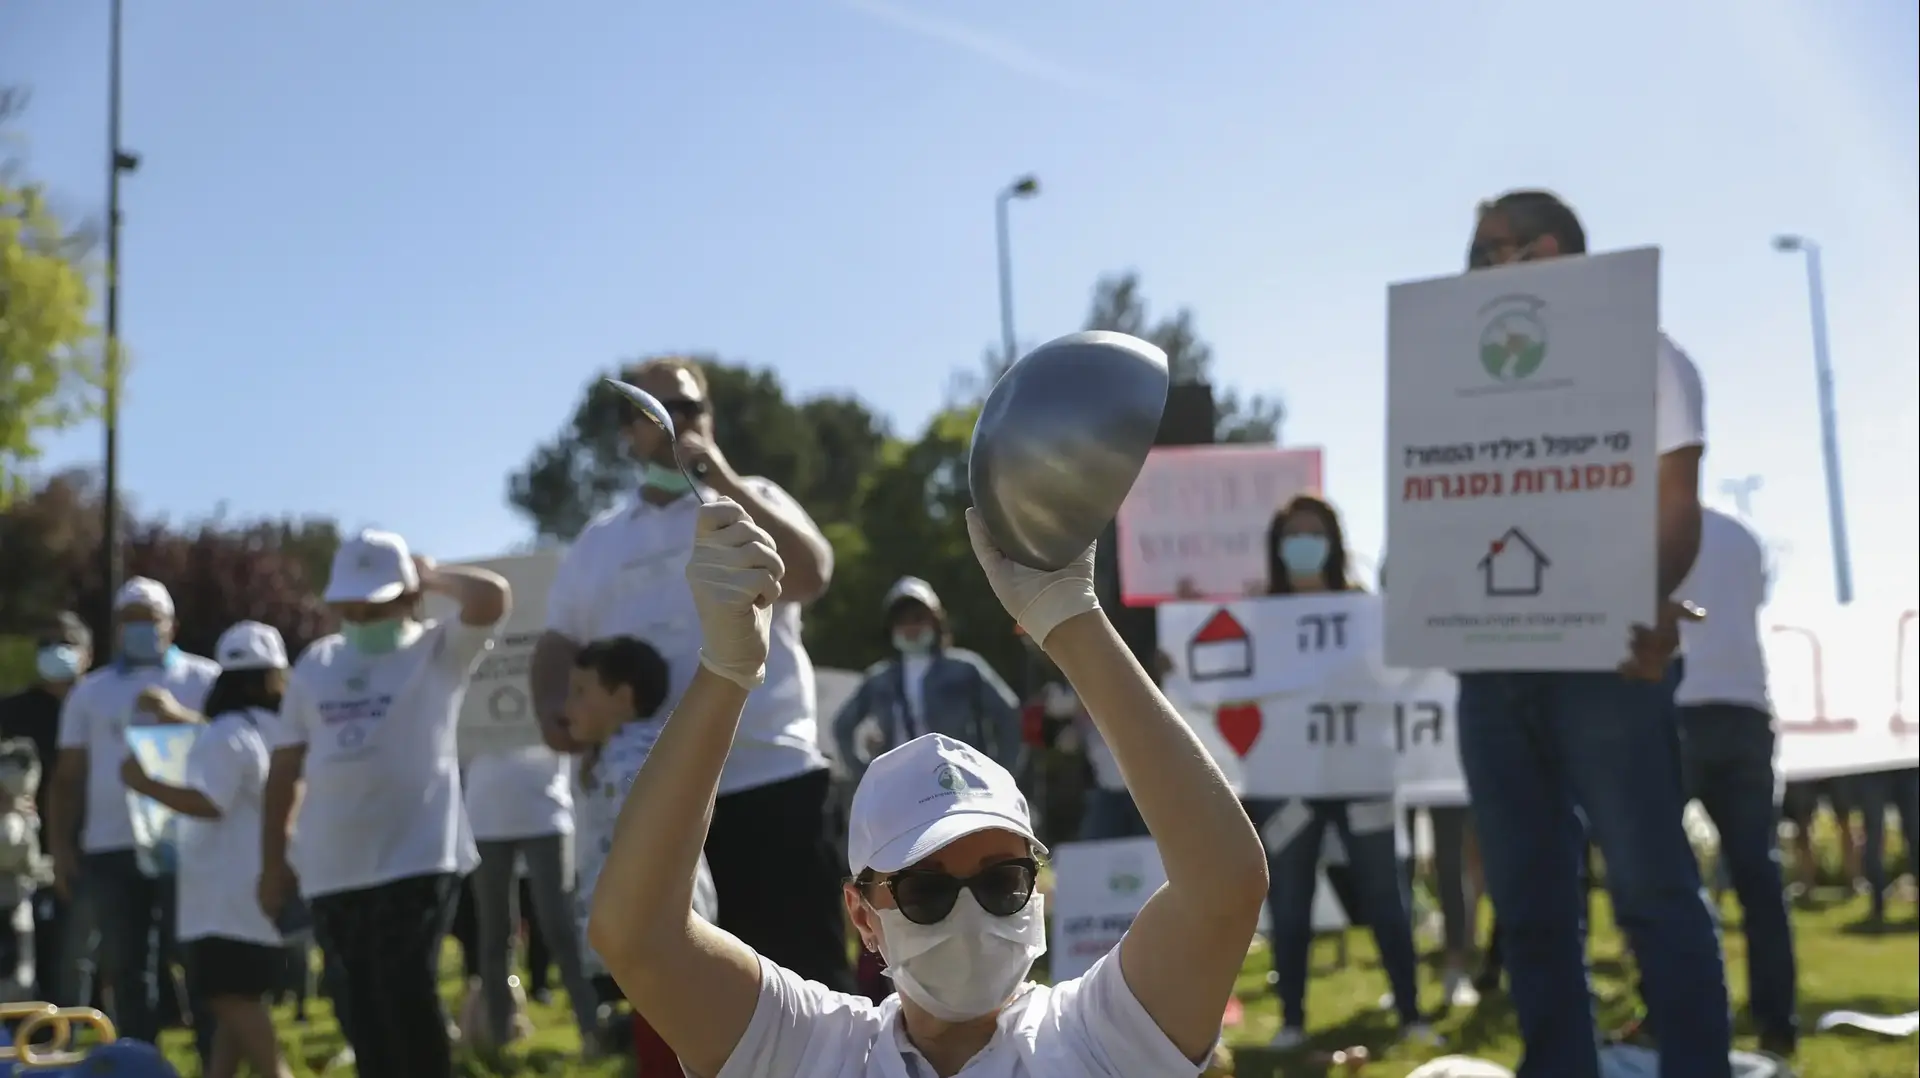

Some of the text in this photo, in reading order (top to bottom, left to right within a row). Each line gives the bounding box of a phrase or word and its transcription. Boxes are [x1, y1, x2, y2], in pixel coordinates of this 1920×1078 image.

[1405, 431, 1631, 467] מי יטפל בילדי המחר?
[1402, 461, 1634, 502] מסגרות נסגרות
[1296, 612, 1348, 652] זה
[1306, 701, 1444, 753] גן זה
